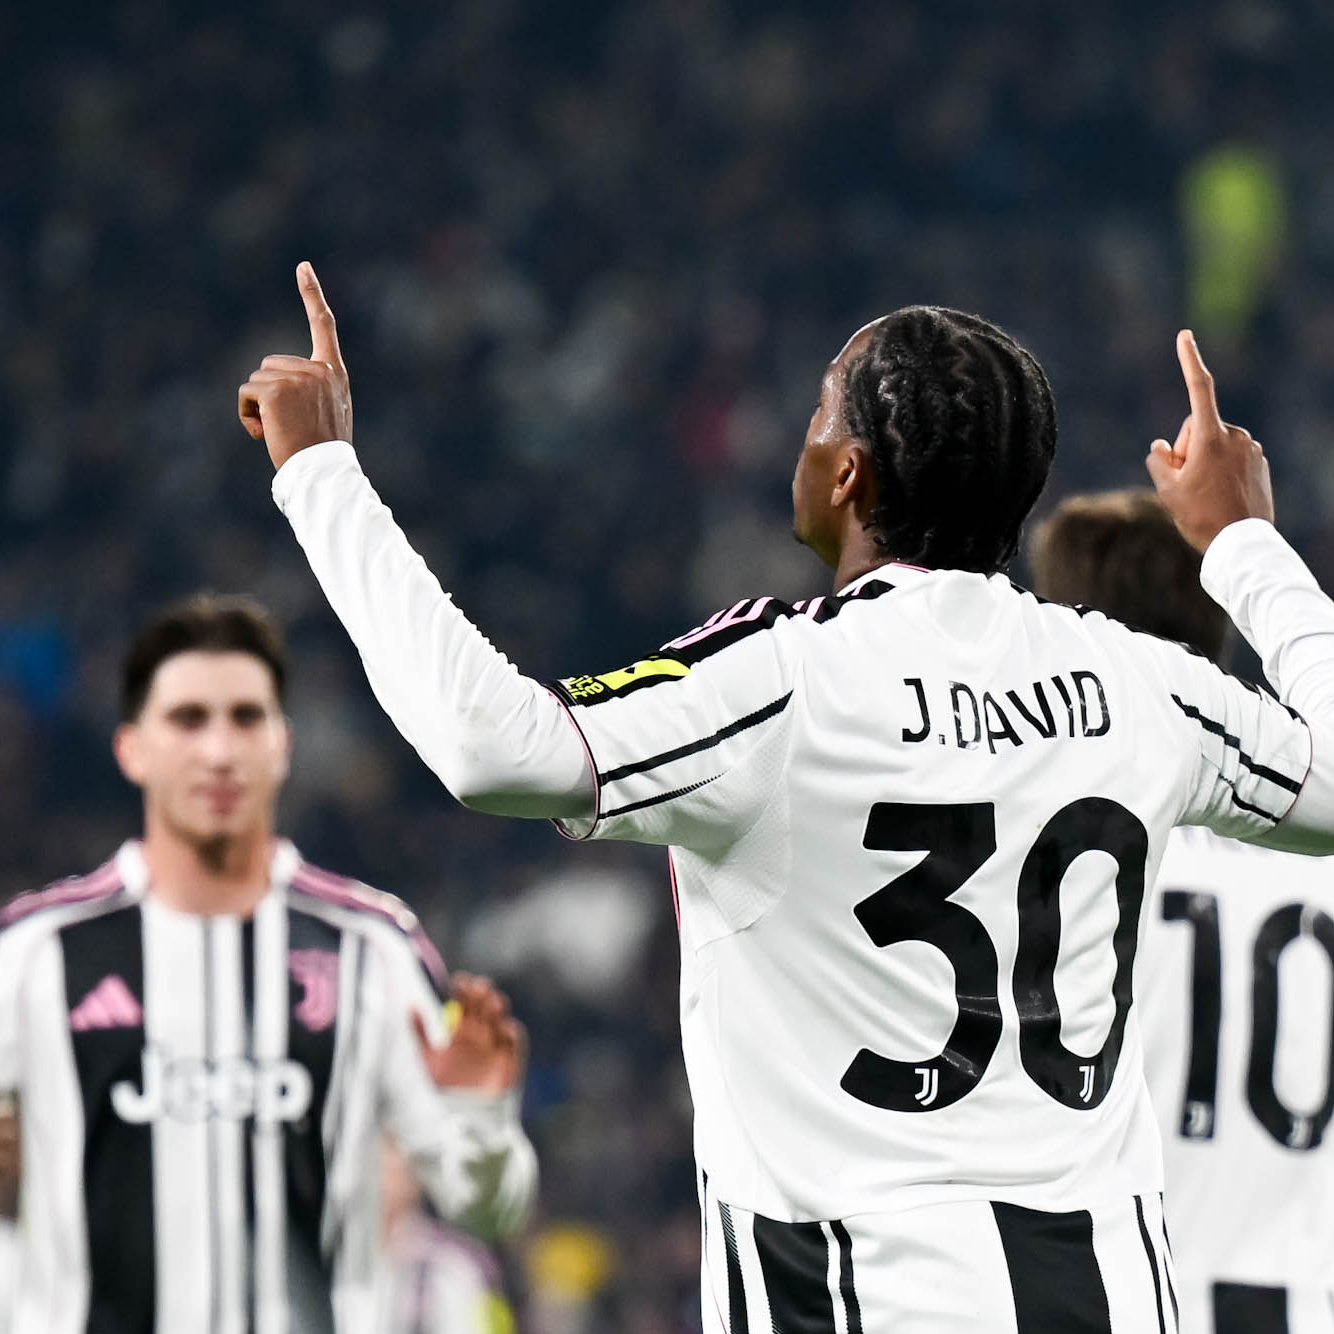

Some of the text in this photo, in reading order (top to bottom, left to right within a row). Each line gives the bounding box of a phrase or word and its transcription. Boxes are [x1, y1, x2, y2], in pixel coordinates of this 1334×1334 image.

[902, 669, 1111, 755] J.DAVID
[839, 796, 1149, 1113] 30
[110, 1045, 314, 1132] Jeep
